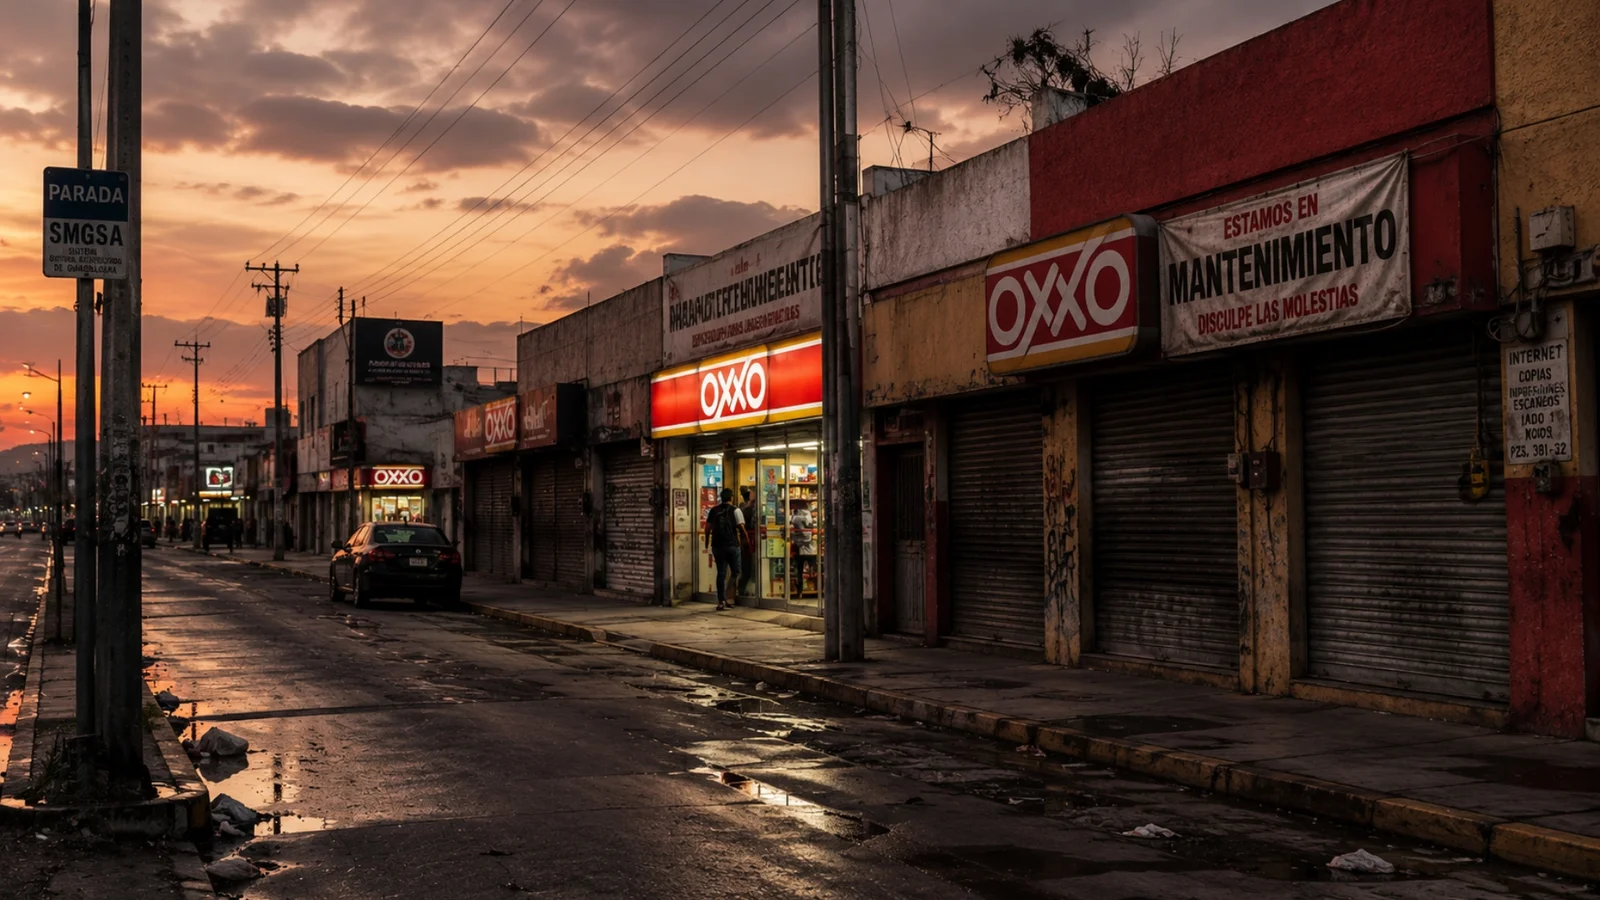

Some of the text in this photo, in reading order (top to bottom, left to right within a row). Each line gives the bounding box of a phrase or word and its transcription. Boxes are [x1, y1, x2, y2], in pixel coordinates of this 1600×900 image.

[48, 183, 124, 204] PARADA
[49, 221, 124, 246] SMGSA
[1223, 193, 1319, 240] ESTAMOS EN
[1168, 209, 1397, 306] MANTENIMIENTO
[988, 244, 1131, 350] OXXO
[1197, 283, 1359, 336] DISCULPE LAS MOLESTIAS
[1509, 344, 1563, 366] INTERNET
[700, 359, 766, 418] OXXO
[1519, 367, 1552, 383] COPIAS
[485, 405, 516, 444] OXXO
[374, 469, 423, 485] OXXO
